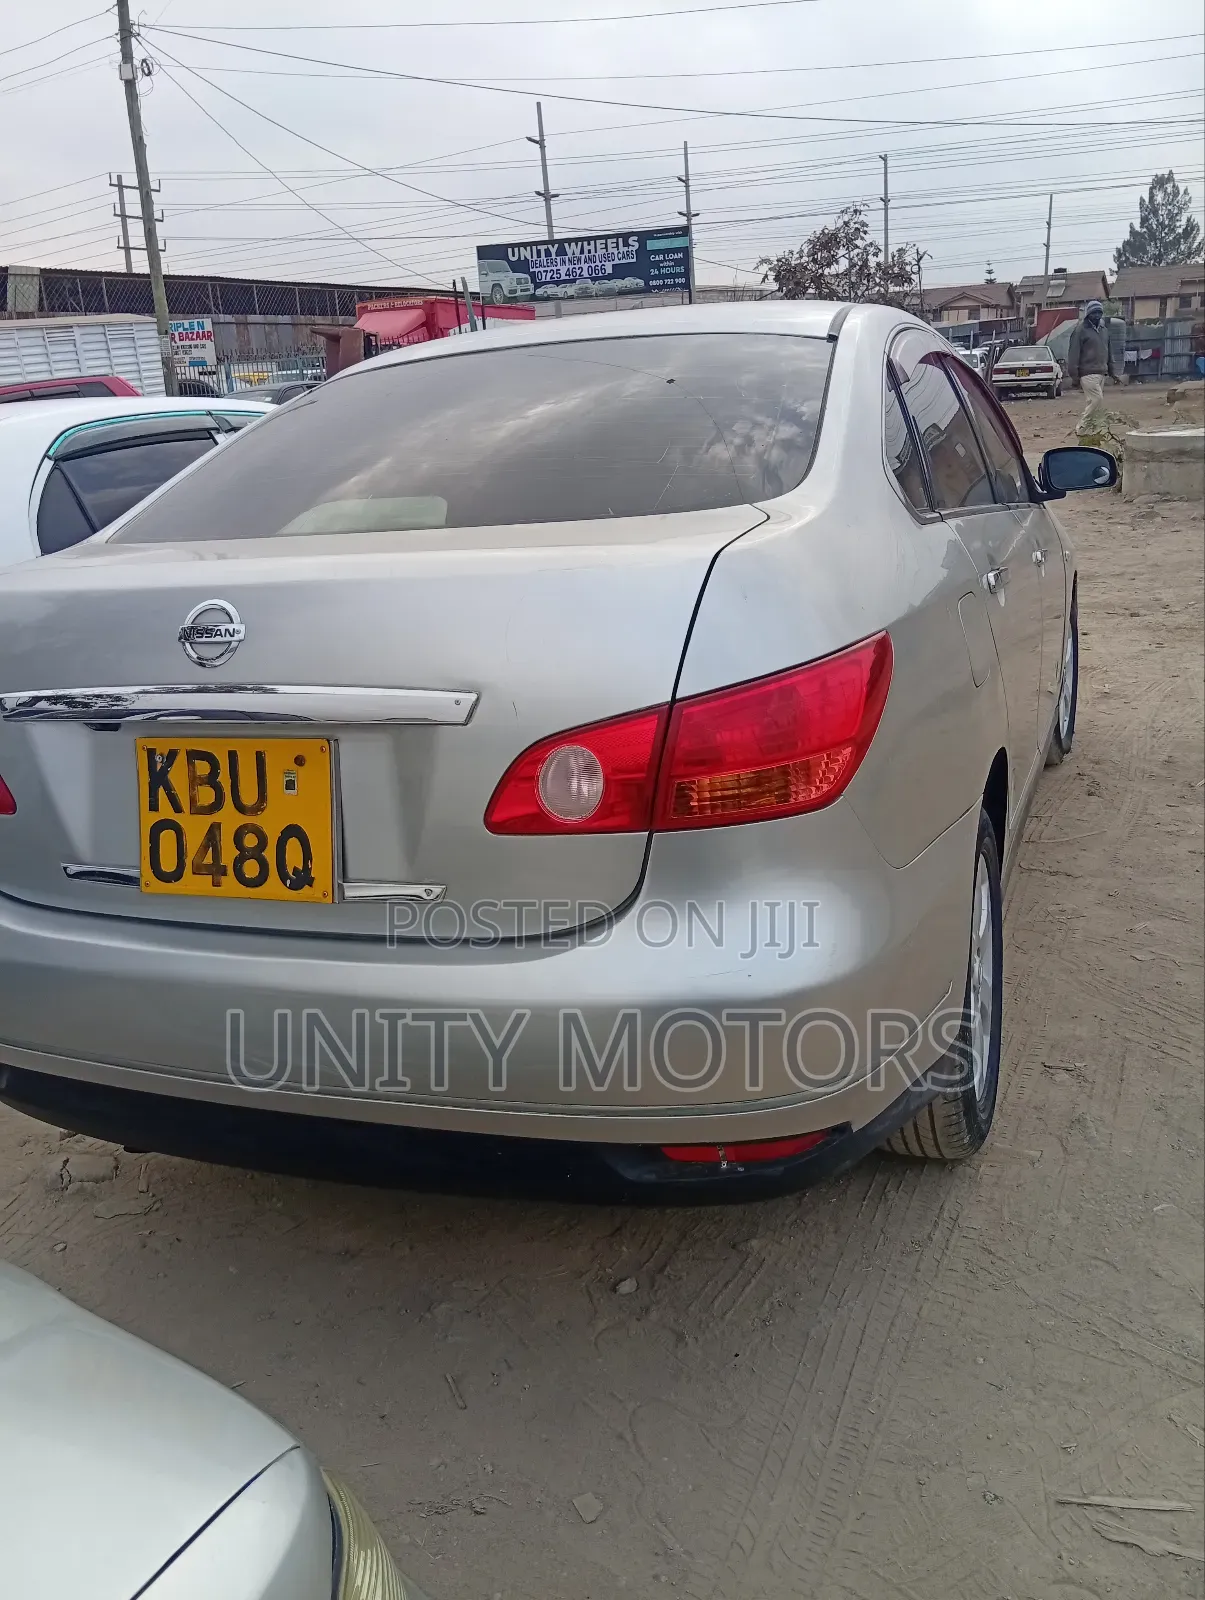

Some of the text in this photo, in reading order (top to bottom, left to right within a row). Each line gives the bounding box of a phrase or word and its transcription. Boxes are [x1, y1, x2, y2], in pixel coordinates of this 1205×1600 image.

[507, 236, 640, 261] UNITY WHEELS
[665, 252, 684, 260] LOAN
[530, 249, 635, 269] DEALERS IN NEW AND USED CARS
[536, 264, 606, 281] 0725 462 066
[649, 265, 685, 276] 24 HOURS
[178, 331, 213, 342] BAZAAR
[183, 624, 236, 641] NISSAN
[146, 747, 268, 816] KBU
[149, 818, 315, 891] 048Q
